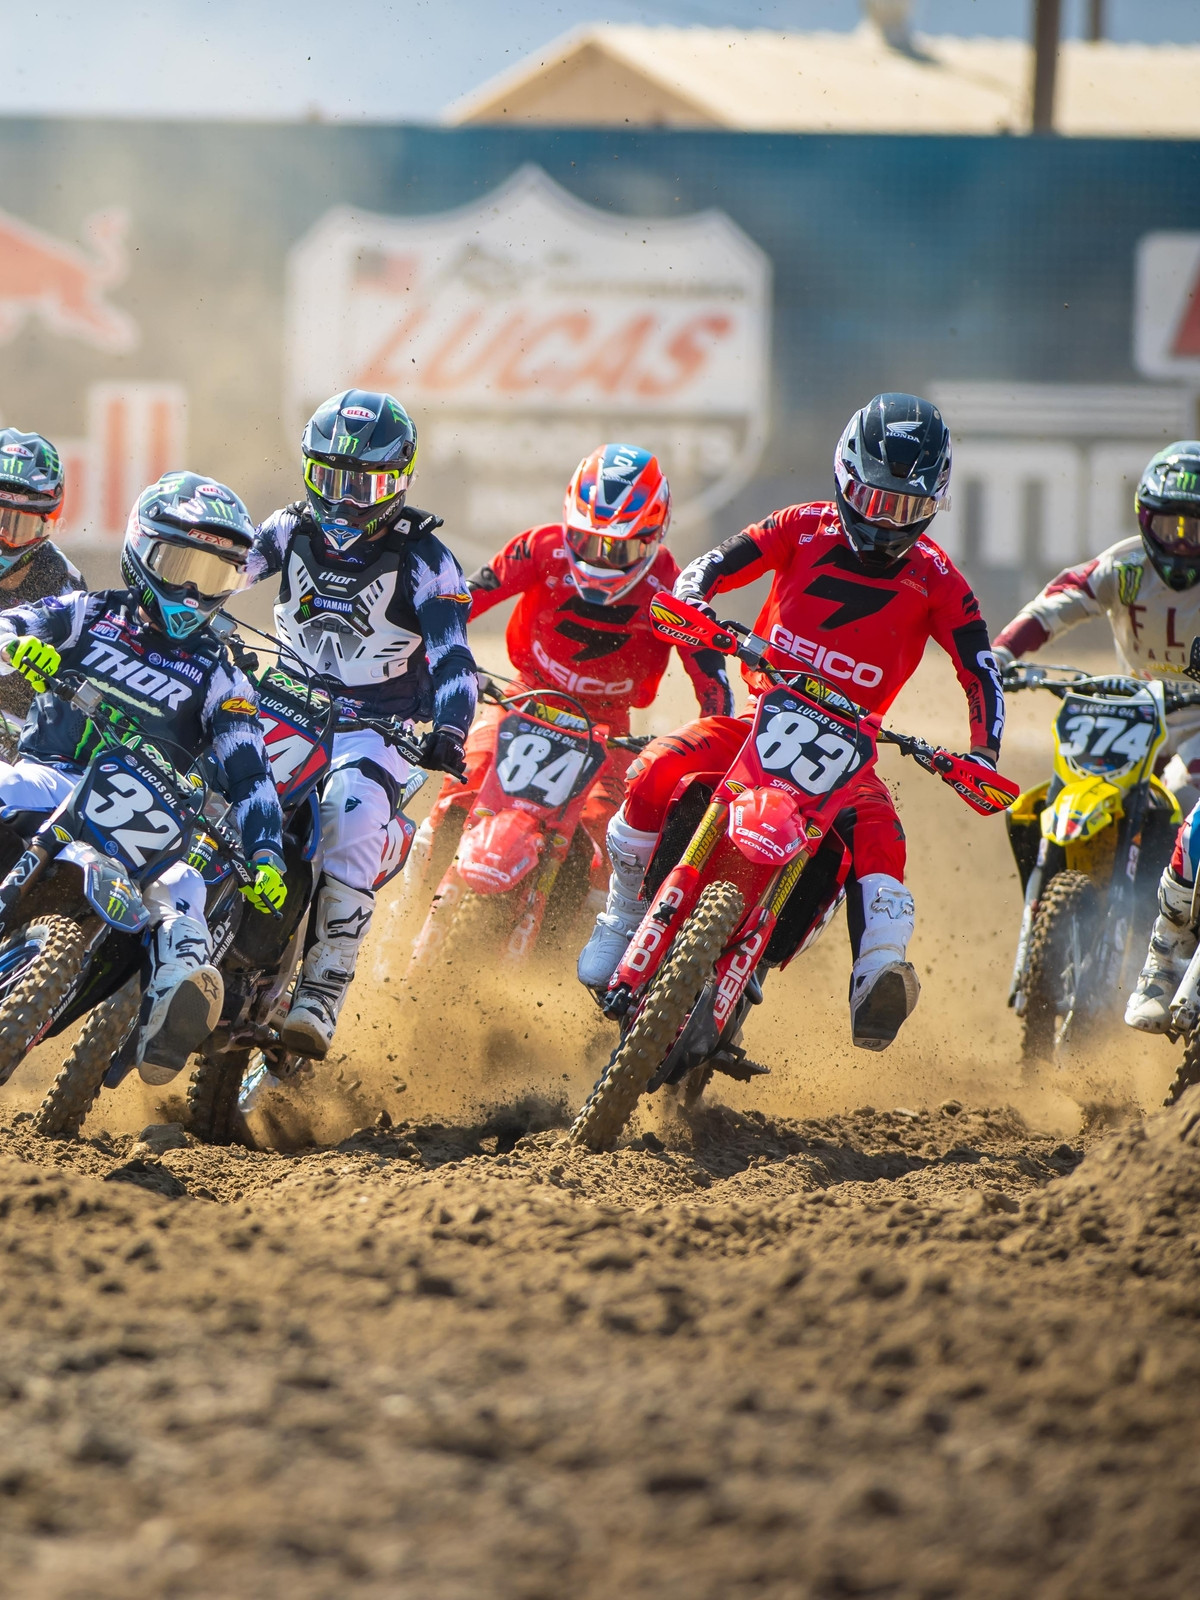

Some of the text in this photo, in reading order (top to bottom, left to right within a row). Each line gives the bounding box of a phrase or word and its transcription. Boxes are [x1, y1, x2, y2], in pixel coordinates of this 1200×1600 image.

[355, 307, 737, 396] LUCAS
[346, 408, 371, 419] BELL
[886, 430, 921, 443] HONDA
[6, 446, 29, 456] BELL
[202, 486, 224, 497] BELL
[600, 475, 634, 486] HONDA
[205, 515, 242, 530] MONST
[800, 506, 837, 517] GEIC
[188, 528, 224, 547] FLEX
[122, 550, 146, 590] MONSTER
[318, 571, 358, 585] thor
[186, 599, 198, 607] BELL
[322, 599, 354, 613] YAMAHA
[93, 623, 117, 638] 100%
[658, 623, 700, 646] CYCRA
[1128, 604, 1186, 648] FL
[531, 639, 634, 695] GEICO
[769, 624, 884, 688] GEICO
[80, 639, 193, 712] THOR
[161, 658, 204, 684] YAMAHA
[260, 695, 311, 728] LUCAS OIL
[795, 705, 845, 737] LUCAS OIL
[1081, 702, 1136, 718] LUCAS OIL
[530, 725, 577, 748] LUCAS OIL
[1059, 715, 1154, 762] 374
[259, 716, 317, 785] 4
[398, 745, 421, 763] ARC
[755, 710, 861, 796] 83
[496, 733, 594, 808] 84
[136, 765, 178, 810] LUCAS OIL
[770, 778, 800, 798] SHIFT
[954, 782, 993, 811] CYCRA
[85, 773, 185, 869] 32
[190, 844, 212, 862] YAMAHA
[735, 827, 786, 857] GEICO
[740, 838, 775, 861] HONDA
[625, 885, 684, 973] GICO
[713, 929, 763, 1021] GEICO
